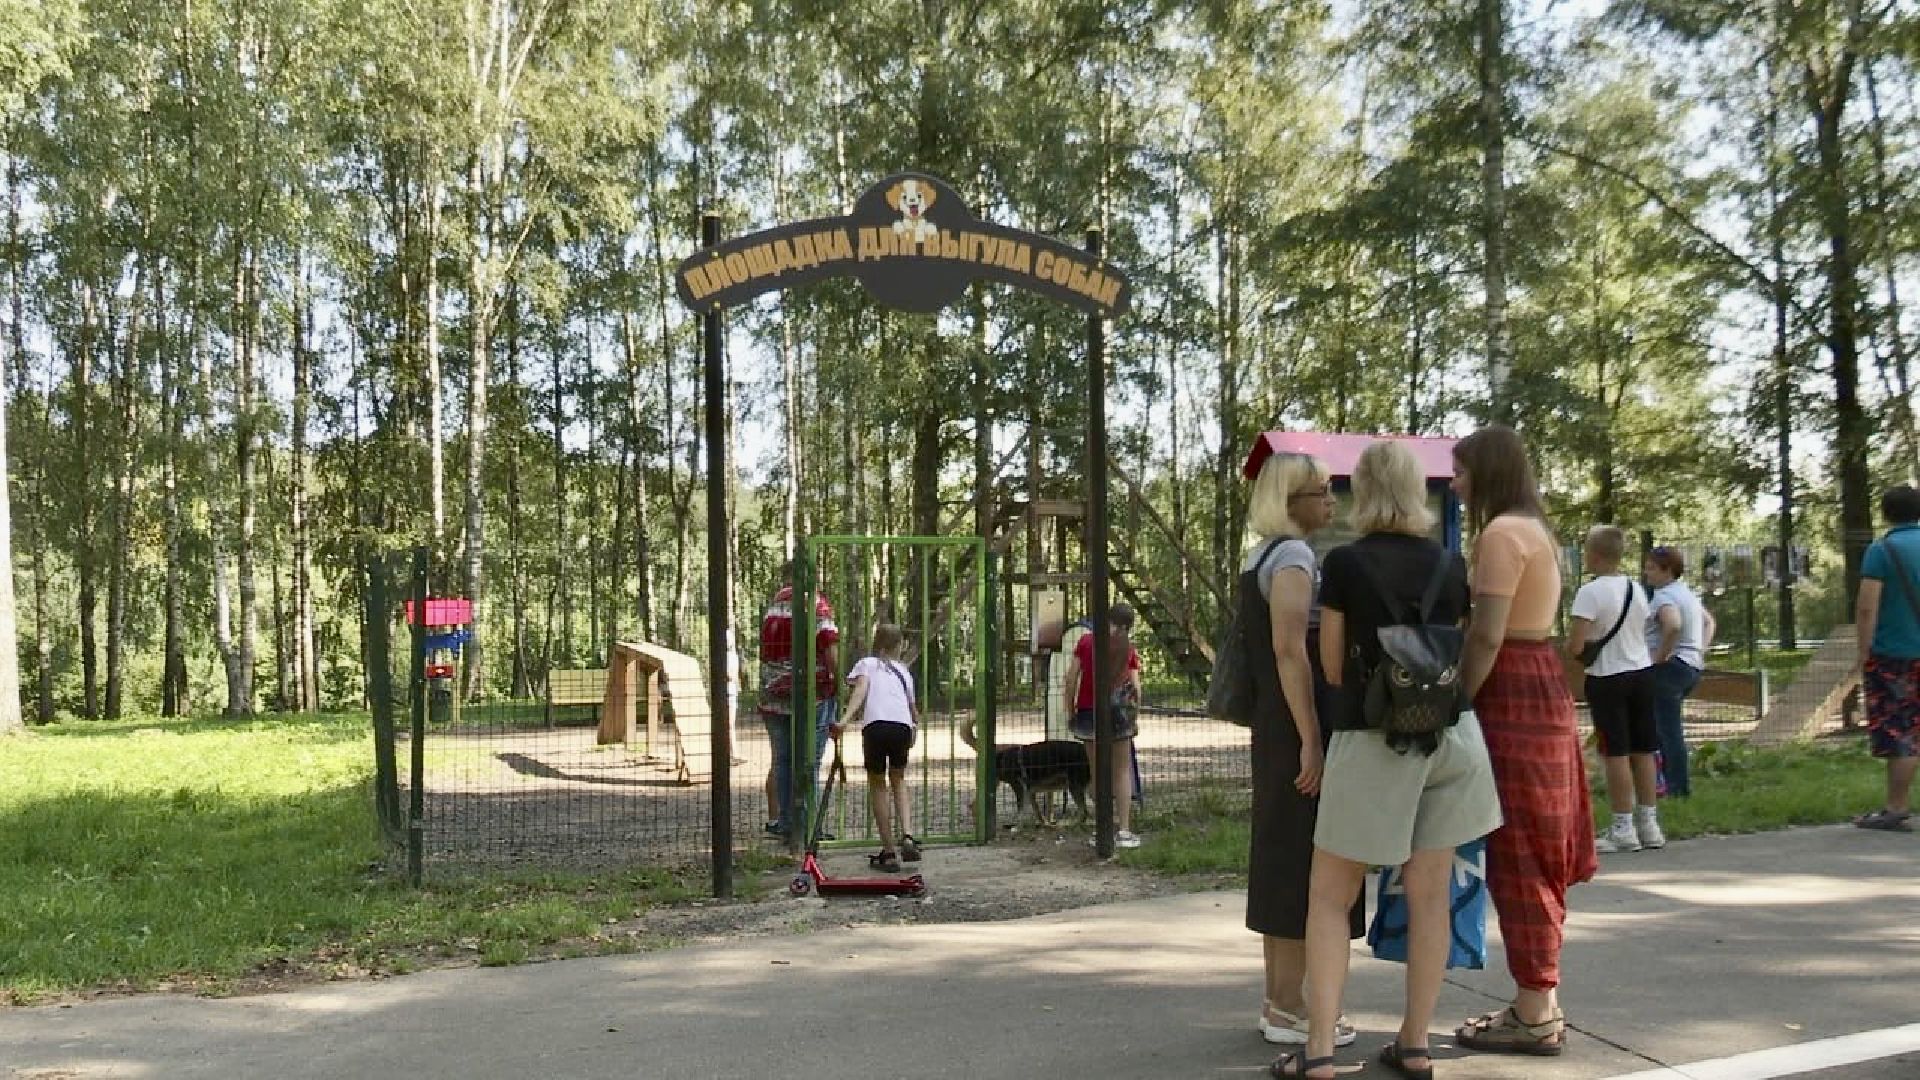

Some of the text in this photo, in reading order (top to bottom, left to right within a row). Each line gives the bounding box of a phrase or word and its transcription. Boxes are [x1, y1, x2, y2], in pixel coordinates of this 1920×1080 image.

[684, 227, 853, 299] ПЛОЩАДКА
[923, 228, 1031, 275] ВЫГУЛА
[1035, 250, 1122, 307] СОБАК
